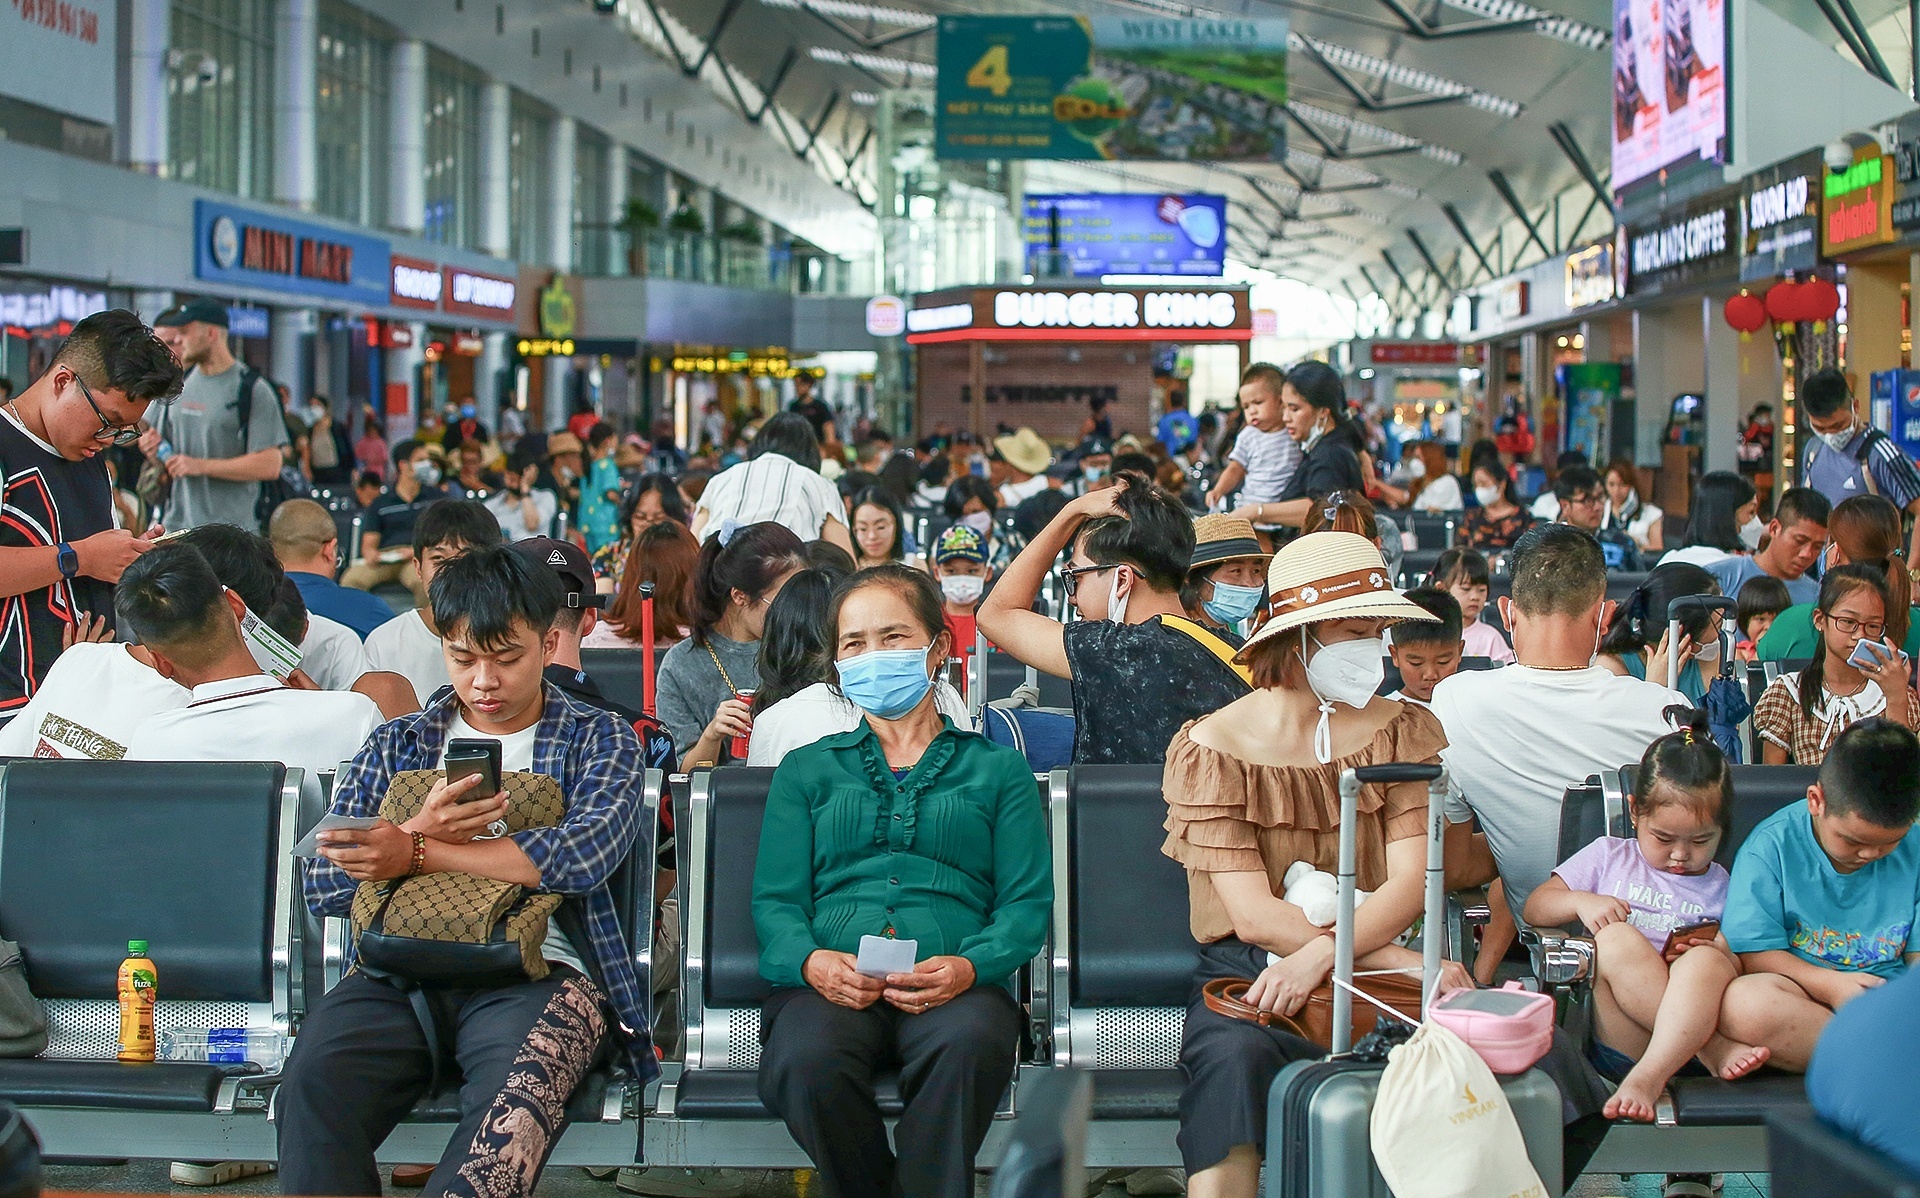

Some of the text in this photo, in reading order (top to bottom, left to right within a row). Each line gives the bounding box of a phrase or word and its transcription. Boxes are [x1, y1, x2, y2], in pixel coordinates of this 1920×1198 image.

[1122, 19, 1259, 39] WEST LAKES
[966, 45, 1013, 96] 4
[243, 225, 353, 283] MINI MART
[1632, 222, 1686, 276] HIGHLANDS
[1686, 207, 1726, 260] COFFEE
[994, 291, 1140, 328] BURGER
[1144, 291, 1236, 328] KING
[43, 719, 104, 754] NO THING
[1613, 880, 1621, 897] I
[1627, 882, 1673, 910] WAKE
[133, 979, 152, 988] fuze
